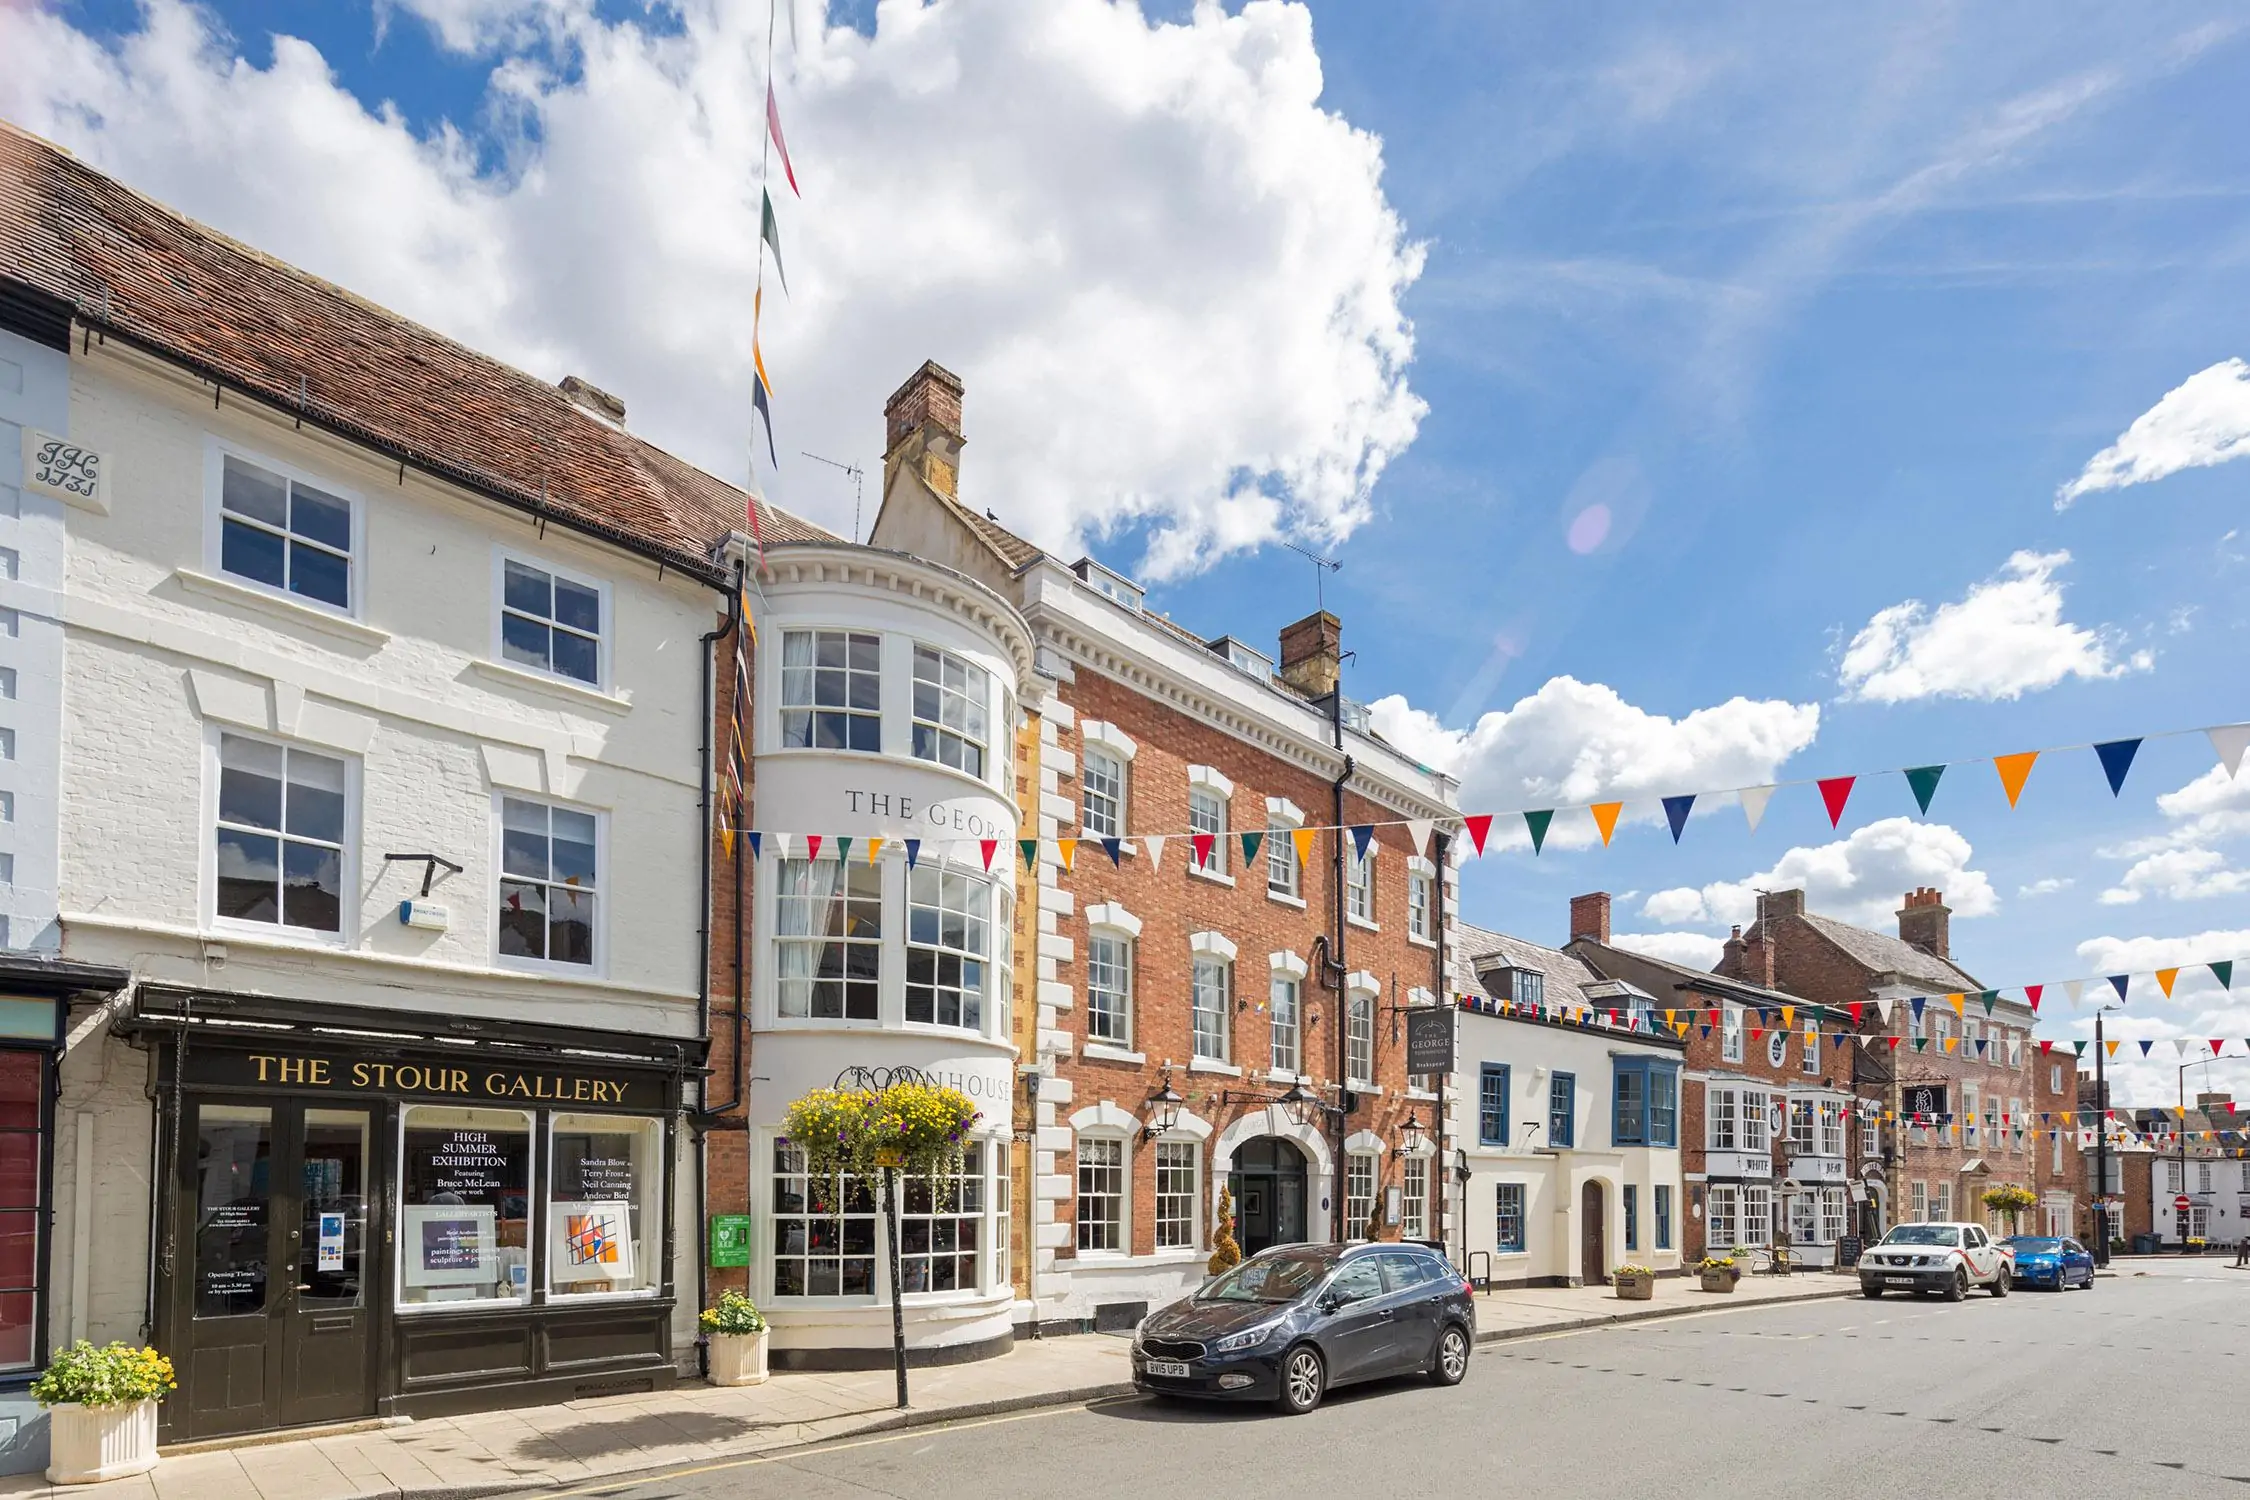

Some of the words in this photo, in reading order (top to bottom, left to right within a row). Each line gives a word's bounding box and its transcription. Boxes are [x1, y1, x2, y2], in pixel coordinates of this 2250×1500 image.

[845, 790, 913, 819] THE
[929, 803, 1013, 857] GEORGE
[1412, 1038, 1450, 1049] GEORGE
[249, 1055, 331, 1085] THE
[352, 1063, 469, 1093] STOUR
[485, 1073, 630, 1103] GALLERY
[454, 1132, 487, 1142] HIGH
[442, 1143, 497, 1154] SUMMER
[432, 1155, 507, 1167] EXHIBITION
[580, 1158, 606, 1166] Sandra
[607, 1158, 626, 1166] Blow
[1747, 1159, 1769, 1171] WHITE
[454, 1169, 485, 1178] Featuring
[1826, 1163, 1842, 1174] BEAR
[582, 1170, 603, 1179] Terry
[605, 1169, 624, 1177] Frost
[437, 1179, 463, 1187] Bruce
[465, 1178, 500, 1187] McLean
[582, 1181, 599, 1189] Neil
[600, 1181, 631, 1190] Canning
[583, 1192, 612, 1200] Andrew
[613, 1192, 629, 1200] Bird
[430, 1255, 463, 1264] sculpture
[207, 1271, 235, 1279] Opening
[1150, 1362, 1166, 1374] BV15
[1167, 1364, 1185, 1375] UPB
